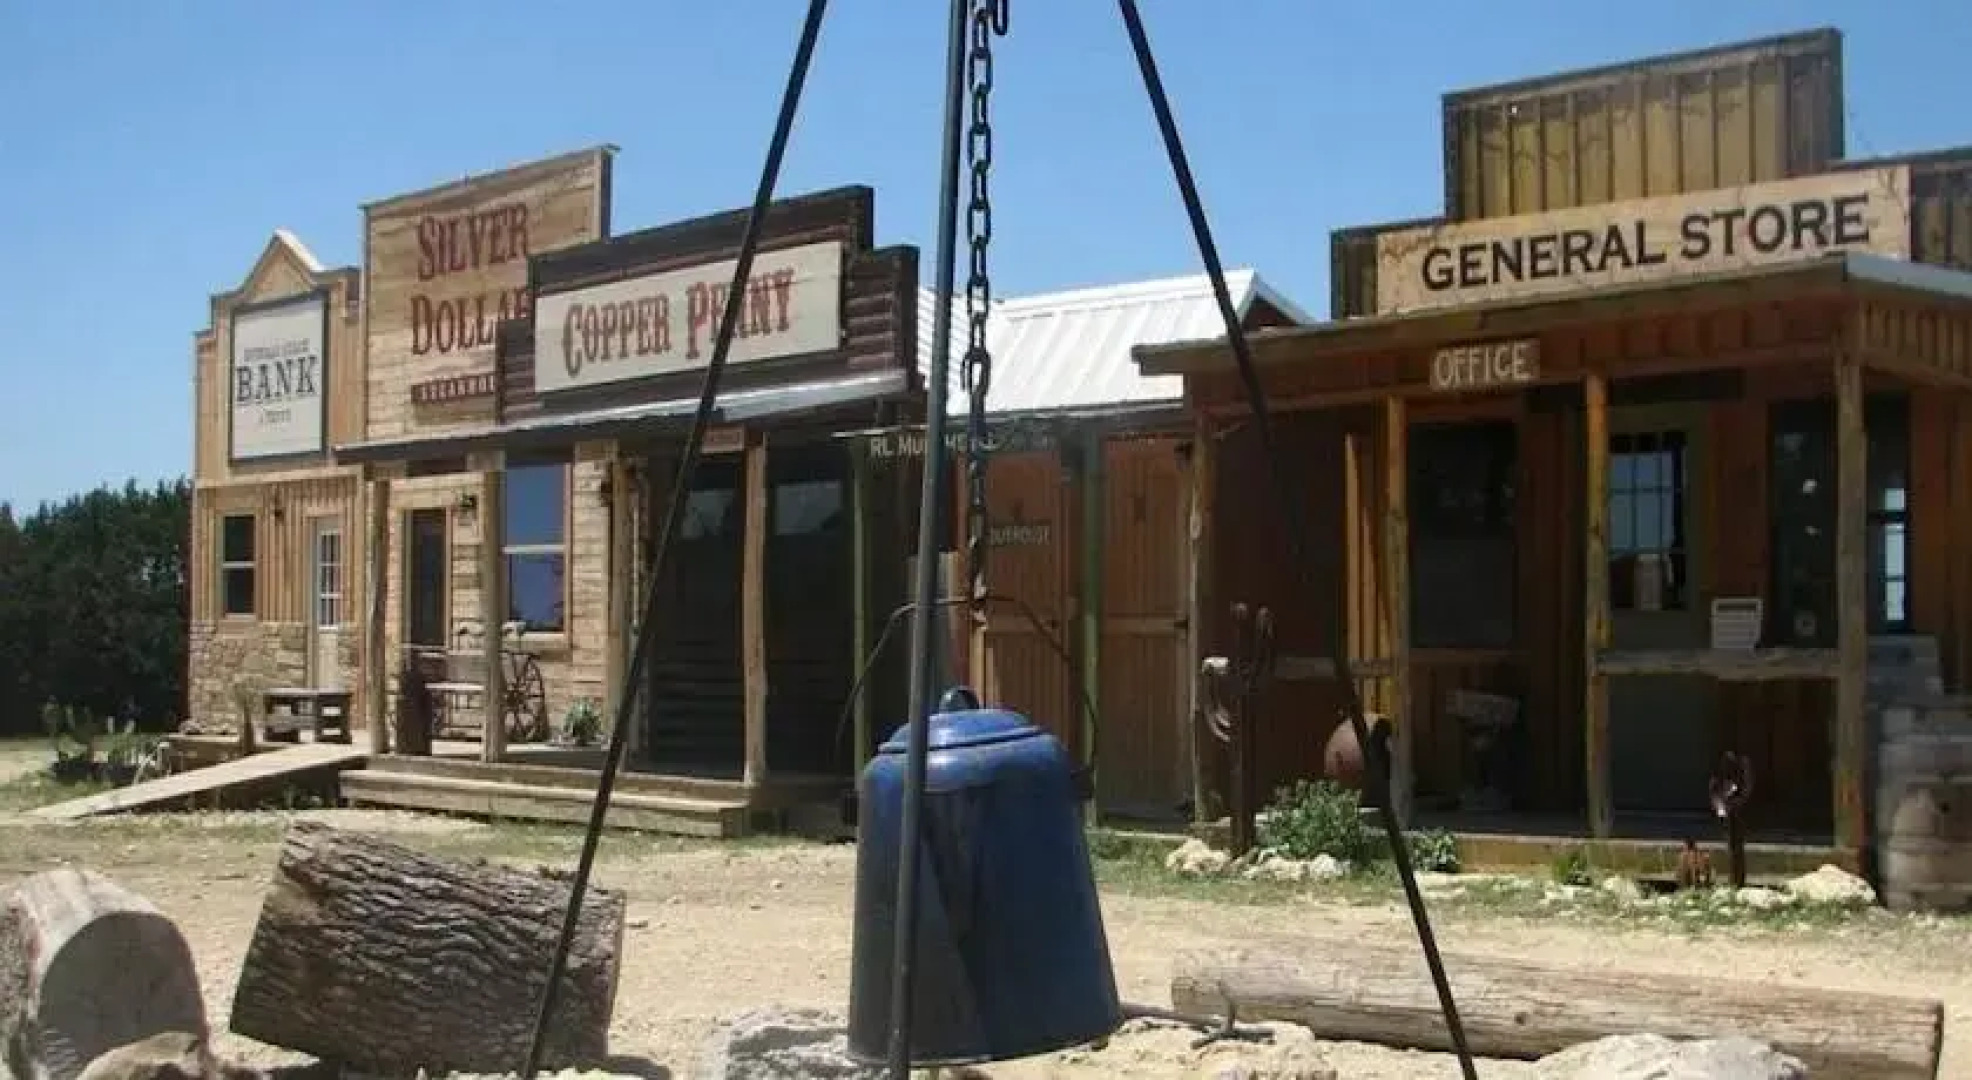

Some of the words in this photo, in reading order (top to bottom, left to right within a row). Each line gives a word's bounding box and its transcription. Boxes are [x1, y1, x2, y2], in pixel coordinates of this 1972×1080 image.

[417, 202, 528, 281] SILVER
[1421, 219, 1667, 291] GENERAL
[1680, 193, 1870, 261] STORE
[562, 292, 672, 378] COPPER
[1433, 342, 1532, 388] OFFICE
[234, 353, 318, 402] BANK
